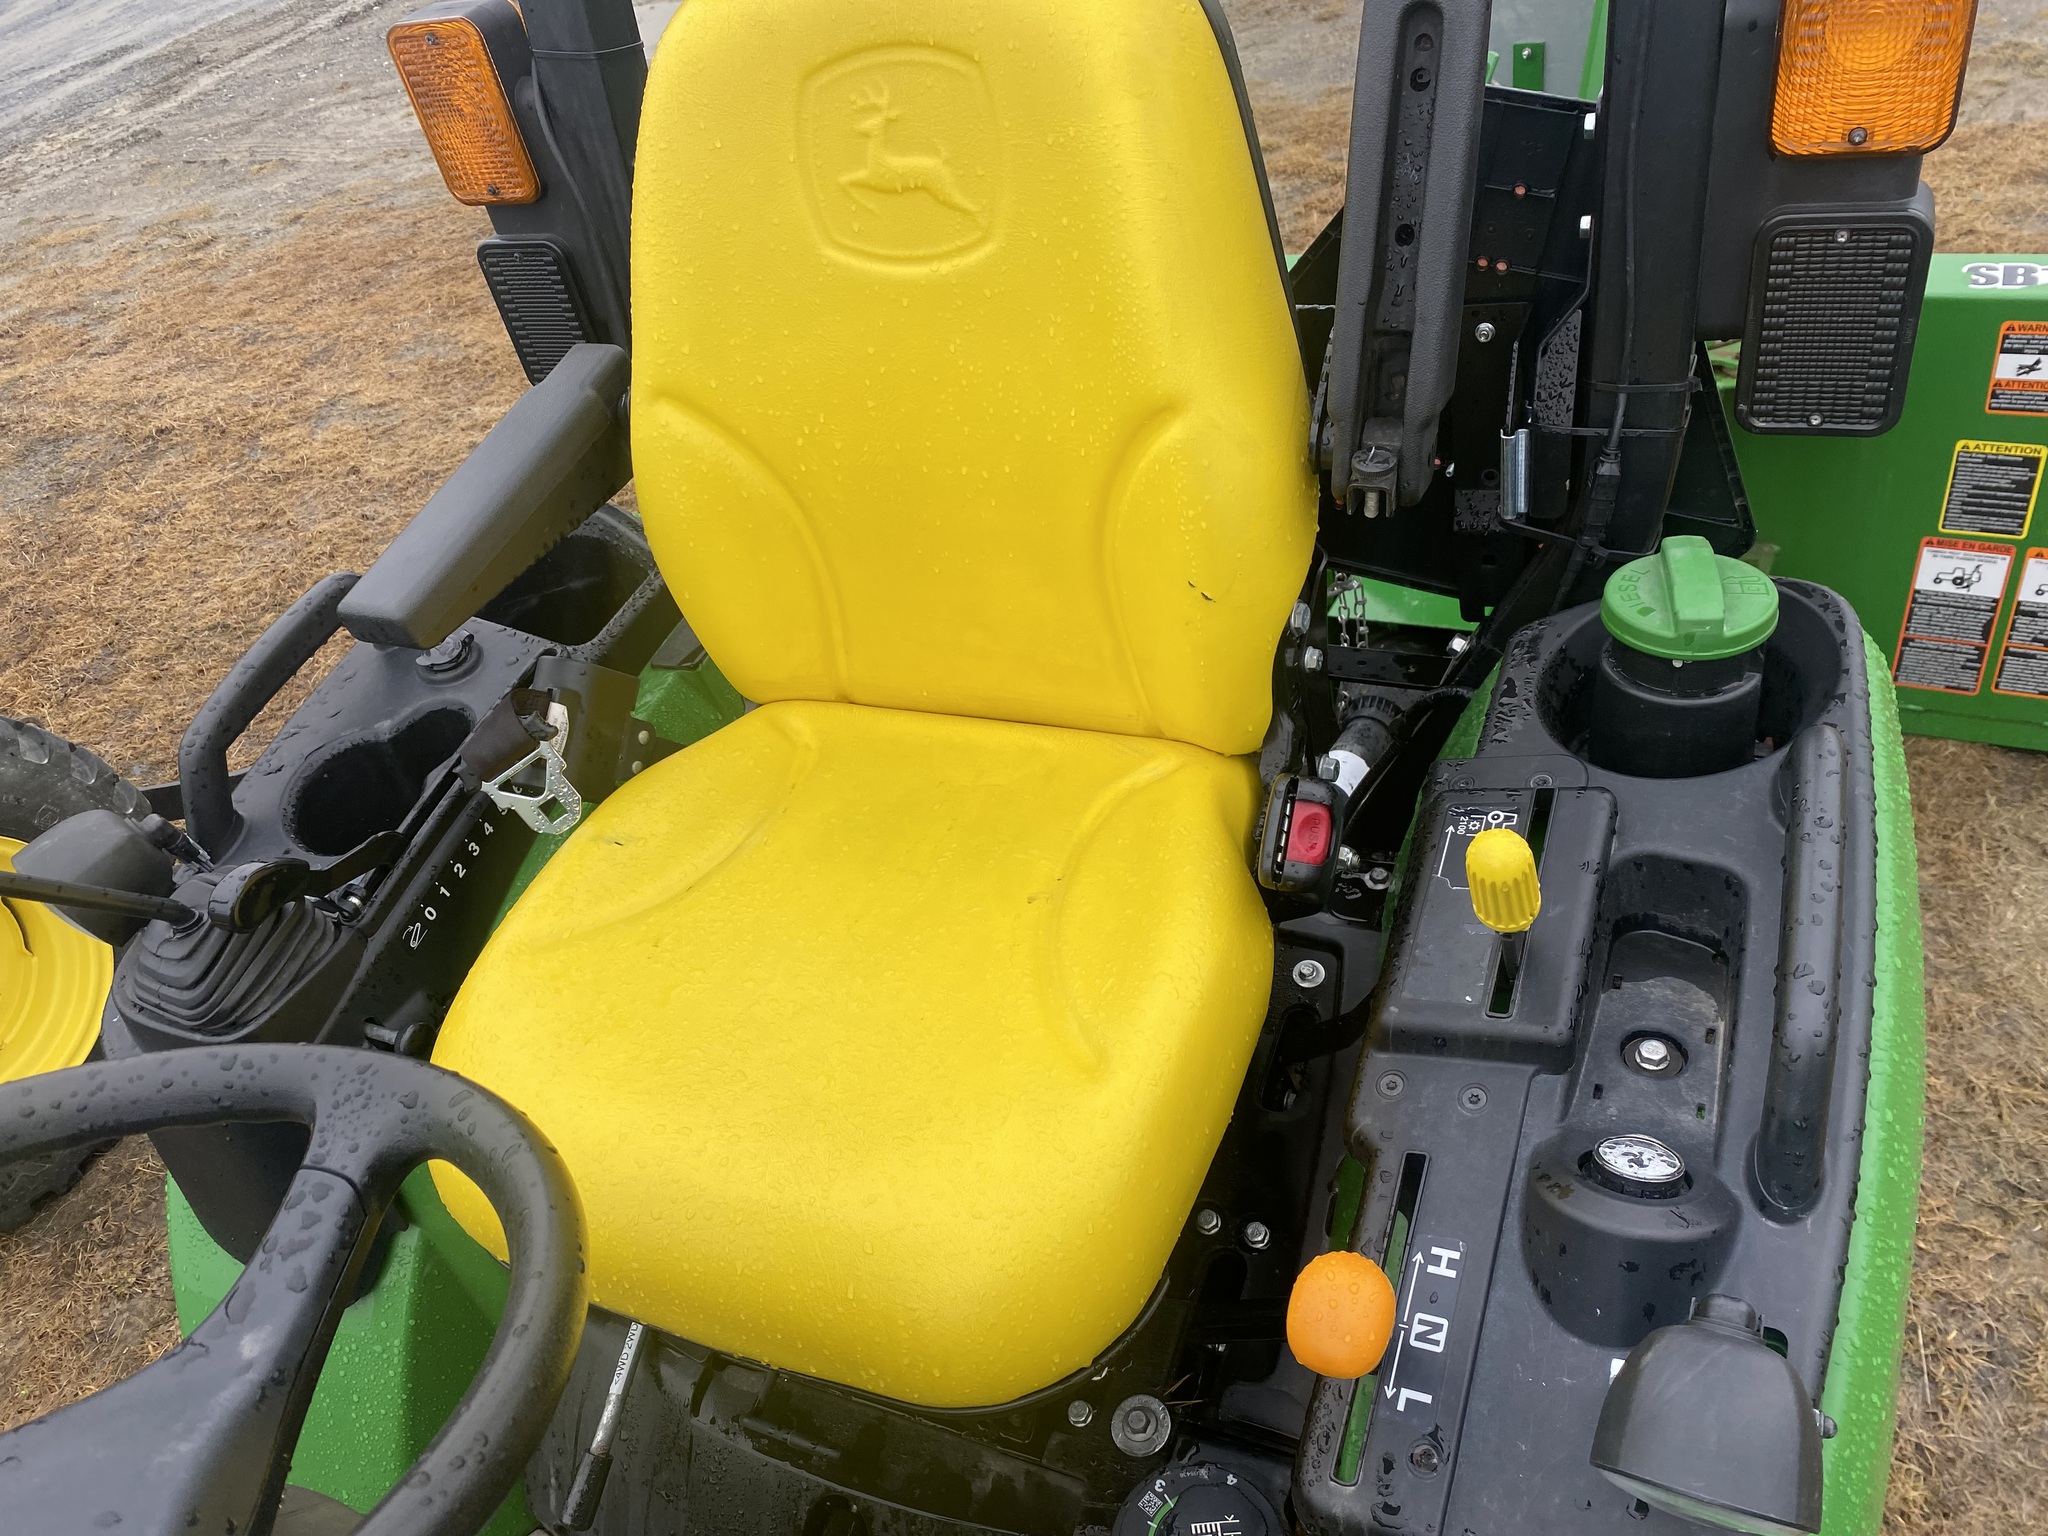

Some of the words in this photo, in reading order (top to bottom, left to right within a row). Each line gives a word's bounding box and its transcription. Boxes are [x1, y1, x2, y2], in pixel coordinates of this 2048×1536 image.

[1964, 264, 2048, 287] SB
[1973, 443, 2042, 455] ATTENTION
[1936, 540, 1958, 548] MISE
[1962, 541, 1976, 550] EN
[1978, 543, 2013, 553] GARDE
[1456, 815, 1470, 835] 2100
[424, 906, 437, 921] 0
[439, 885, 452, 898] 1
[453, 863, 467, 879] 2
[468, 841, 481, 857] 3
[483, 821, 495, 836] 4
[1426, 1245, 1461, 1279] H
[625, 1323, 639, 1350] 2WD
[1412, 1316, 1444, 1349] N
[1396, 1387, 1433, 1412] L
